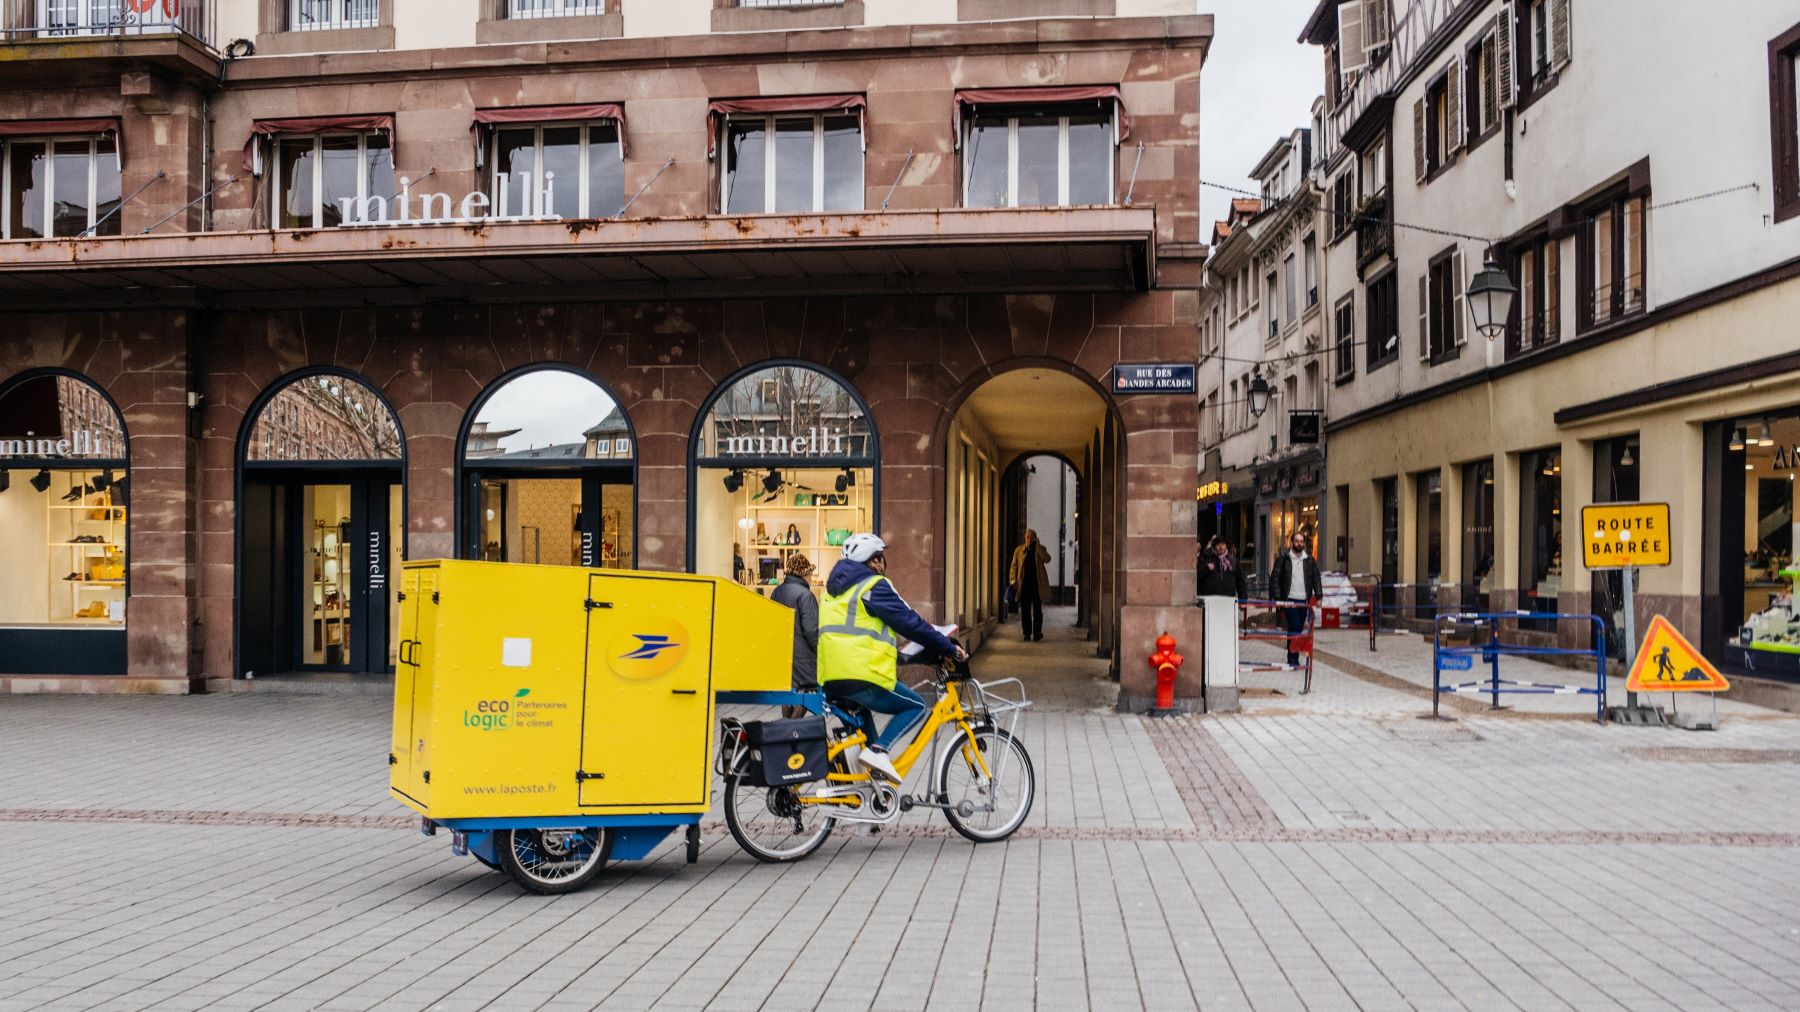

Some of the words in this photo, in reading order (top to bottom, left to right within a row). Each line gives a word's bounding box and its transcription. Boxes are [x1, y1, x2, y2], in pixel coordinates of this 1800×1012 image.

[338, 171, 556, 226] minelli
[1136, 369, 1153, 378] RUE
[1155, 369, 1172, 378] DES
[1155, 379, 1191, 388] ARCADES
[0, 430, 102, 456] minelli
[727, 426, 843, 454] minelli
[1597, 517, 1654, 531] ROUTE
[1592, 538, 1662, 554] BARRÉE
[369, 531, 384, 588] minelli
[478, 700, 509, 713] eco
[517, 701, 567, 709] Partenaires
[464, 710, 507, 731] logic
[464, 783, 557, 796] www.laposte.fr
